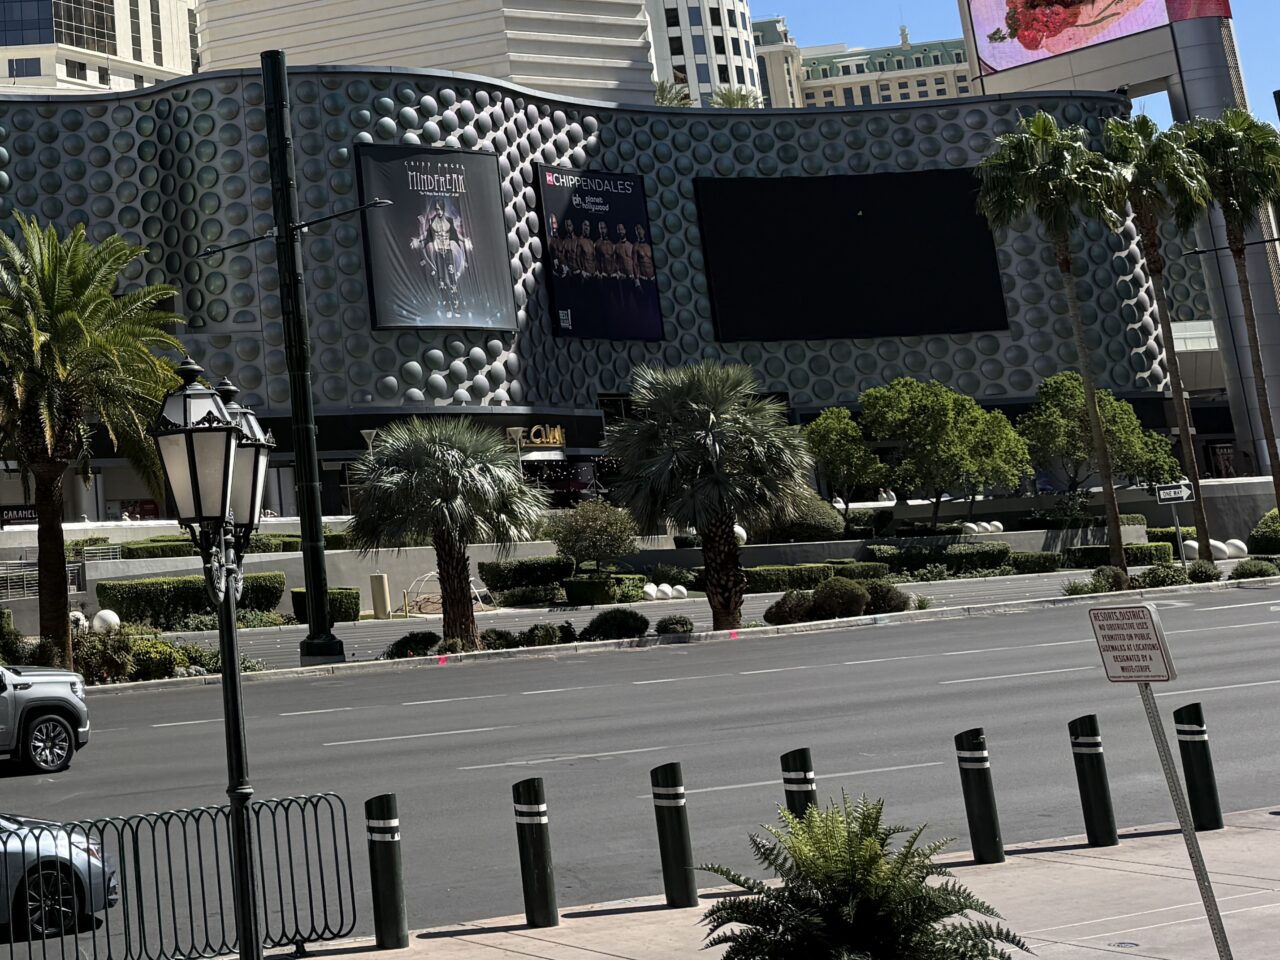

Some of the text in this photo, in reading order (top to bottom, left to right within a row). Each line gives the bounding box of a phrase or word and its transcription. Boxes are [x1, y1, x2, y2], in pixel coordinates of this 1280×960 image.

[408, 171, 466, 193] MINDFREAK
[585, 195, 603, 203] planet
[582, 202, 609, 212] hollywood
[3, 510, 38, 519] CARAMEL
[1092, 611, 1118, 622] RESORTS
[1106, 623, 1135, 631] OBSTRUCTIVE
[1134, 633, 1152, 641] PUBLIC
[1133, 643, 1160, 651] LOCATIONS
